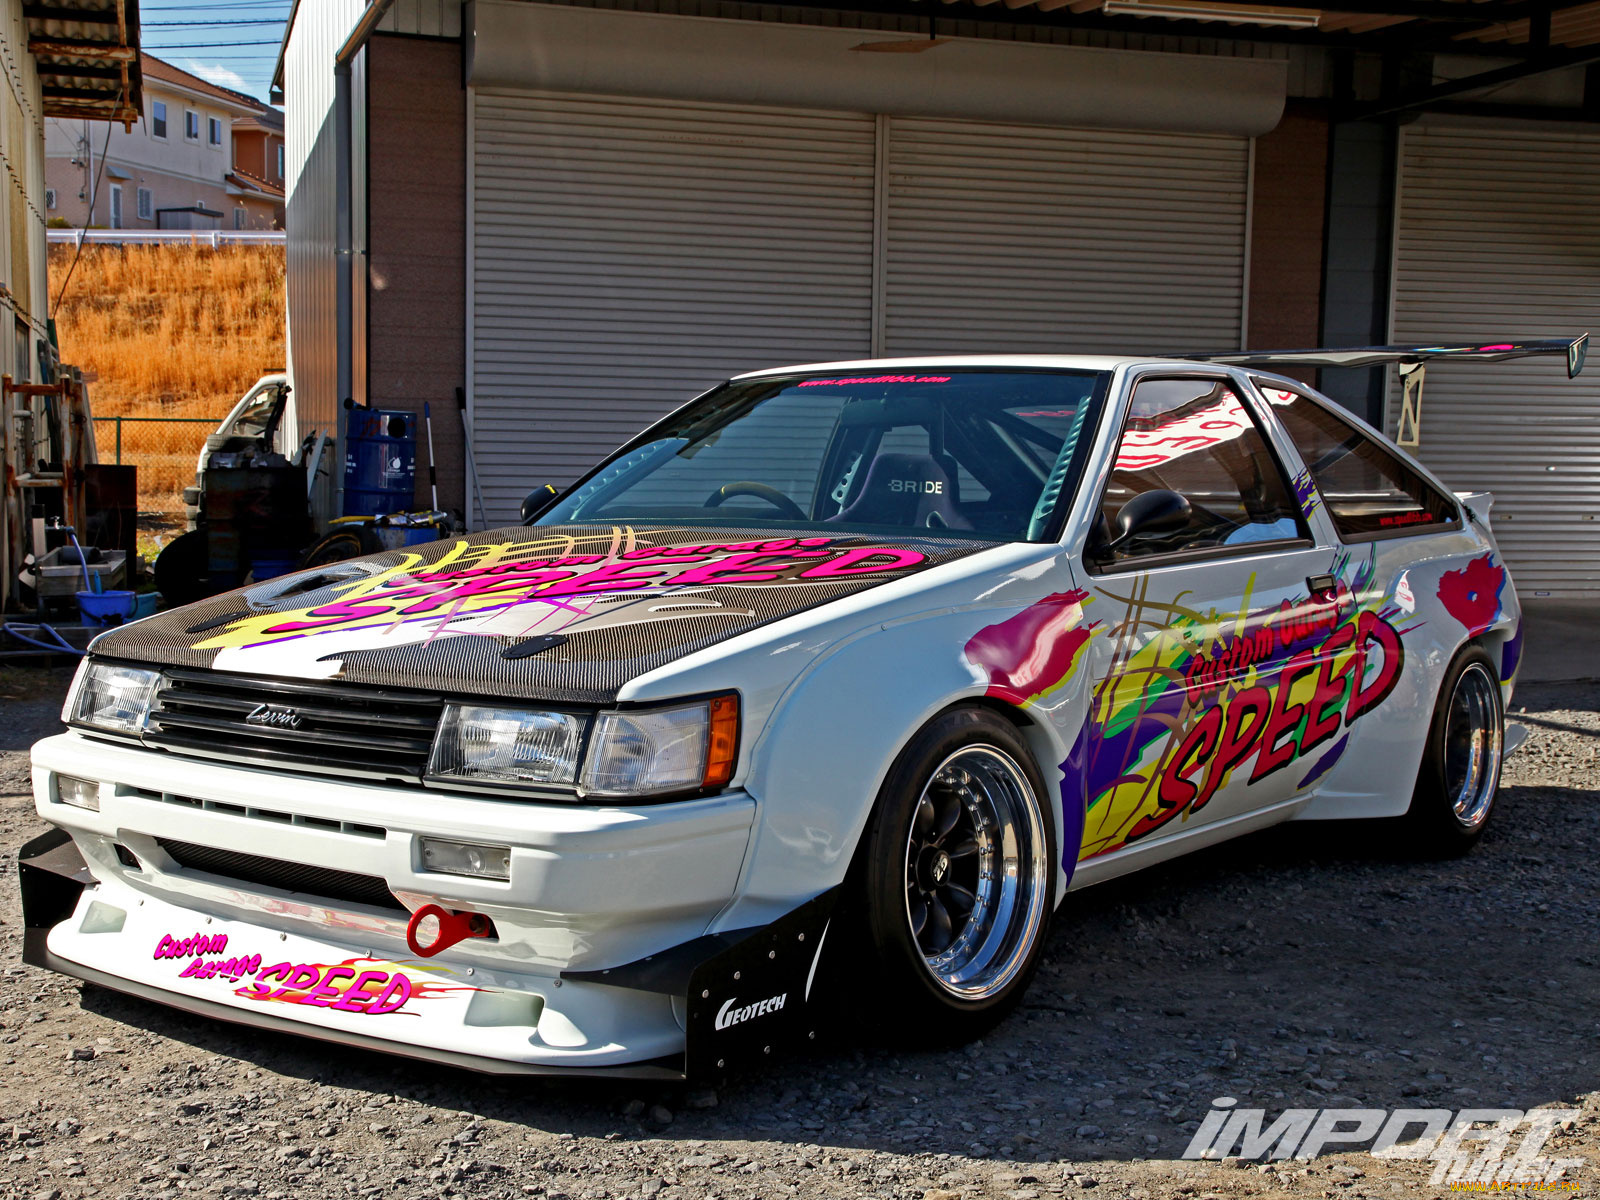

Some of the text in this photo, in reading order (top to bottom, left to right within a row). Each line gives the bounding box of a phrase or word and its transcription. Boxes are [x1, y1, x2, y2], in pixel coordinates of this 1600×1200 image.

[888, 479, 943, 494] BRIDE
[618, 536, 833, 560] Garage
[260, 548, 928, 634] SPEED
[1185, 626, 1276, 708] Custom
[246, 703, 301, 727] Levin
[1124, 610, 1405, 843] SPEED
[153, 932, 228, 960] Custom
[178, 953, 262, 982] Garage
[235, 961, 412, 1015] SPEED
[715, 992, 788, 1031] GEOTECH
